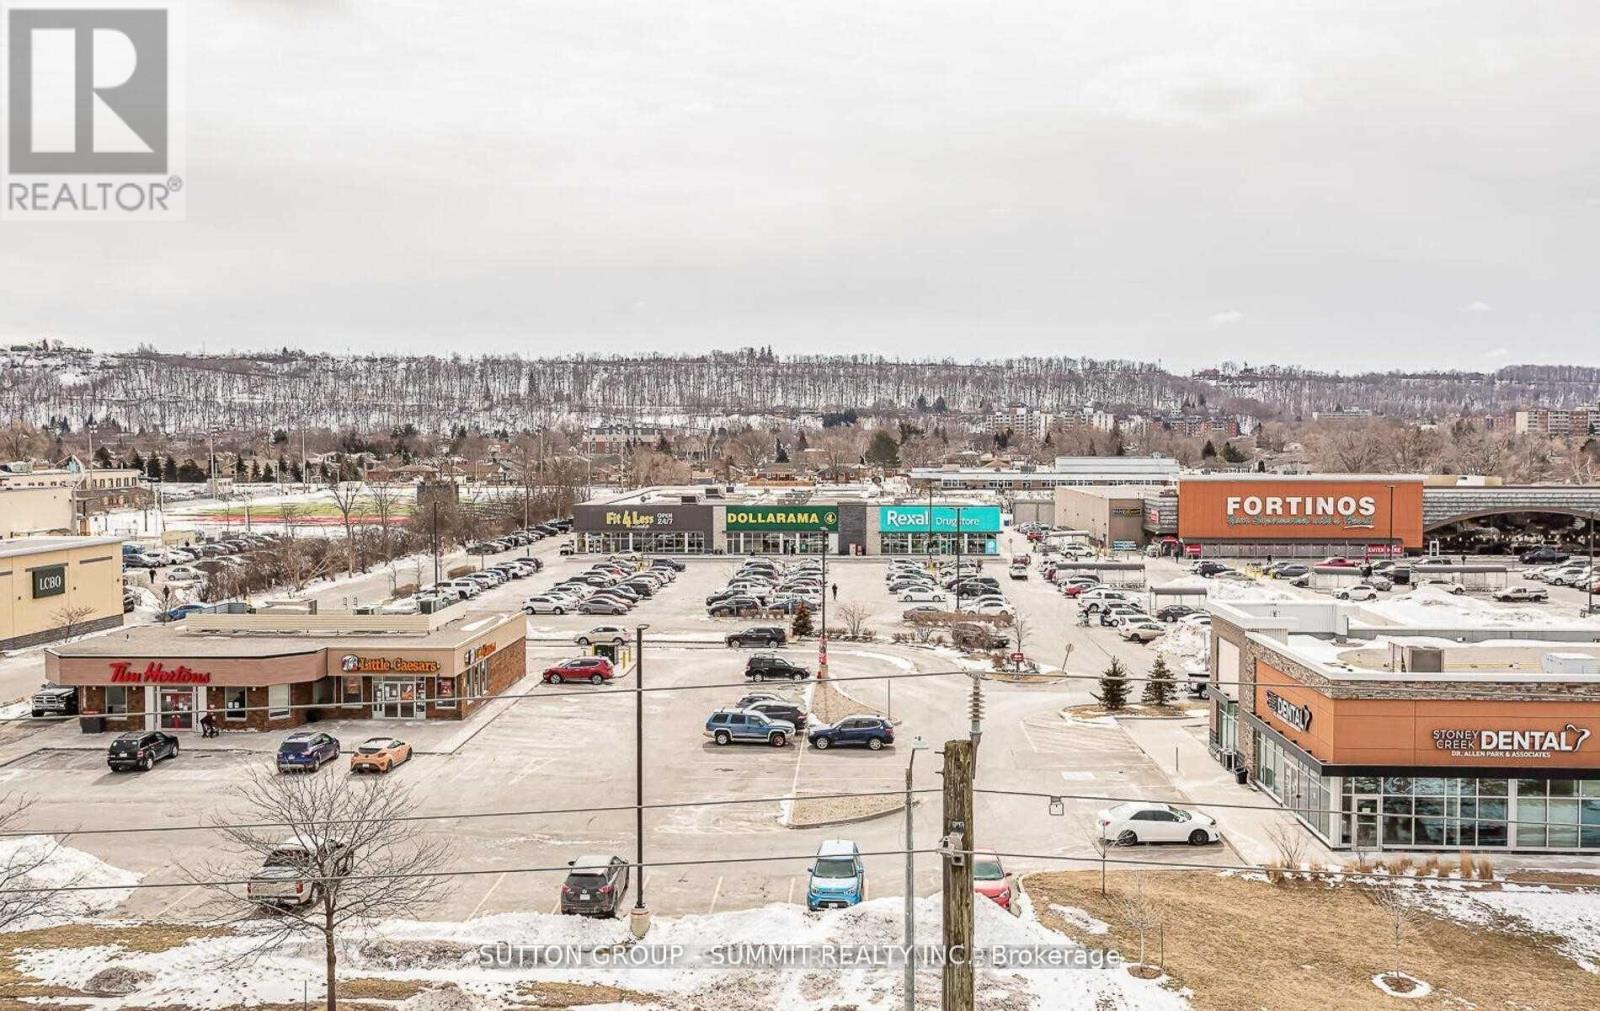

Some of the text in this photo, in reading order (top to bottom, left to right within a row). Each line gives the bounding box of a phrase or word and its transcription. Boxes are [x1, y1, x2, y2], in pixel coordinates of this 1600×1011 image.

[1227, 496, 1376, 515] FORTINOS
[606, 511, 621, 525] Fit
[632, 511, 654, 525] Less
[727, 512, 819, 523] DOLLARAMA
[935, 516, 980, 528] Drugtore
[40, 575, 62, 591] LCBO
[109, 660, 211, 684] Tim Hortons
[359, 657, 438, 673] Little Caesars
[1277, 696, 1304, 731] DENTAL
[1432, 729, 1479, 740] STONEY
[1480, 730, 1573, 751] DENTAL
[1436, 739, 1475, 750] CREEK
[1464, 750, 1486, 758] ALLEN
[1486, 750, 1504, 758] PARK
[1511, 751, 1551, 759] ASSOCIATES
